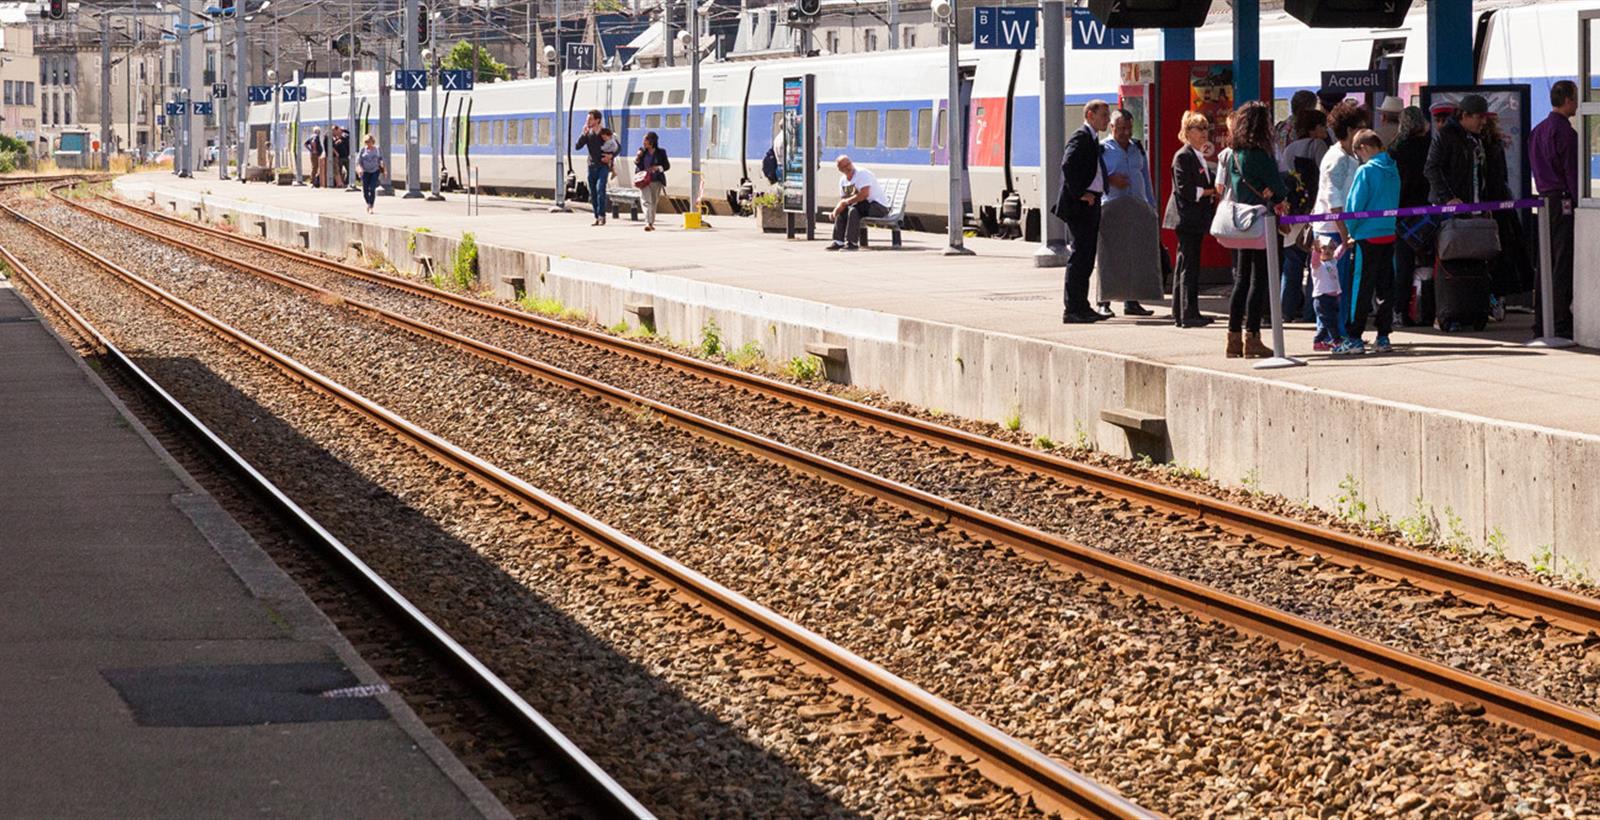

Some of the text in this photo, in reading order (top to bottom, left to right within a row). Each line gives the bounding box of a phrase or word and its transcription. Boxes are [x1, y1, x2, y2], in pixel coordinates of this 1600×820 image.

[980, 15, 988, 25] B
[1001, 20, 1030, 45] W
[1078, 20, 1106, 45] W
[576, 55, 582, 69] 1
[411, 74, 424, 89] X
[445, 74, 457, 89] X
[1328, 73, 1380, 87] Accueil
[259, 88, 271, 101] Y
[285, 88, 297, 101] Y
[176, 103, 184, 114] Z
[195, 103, 204, 114] Z
